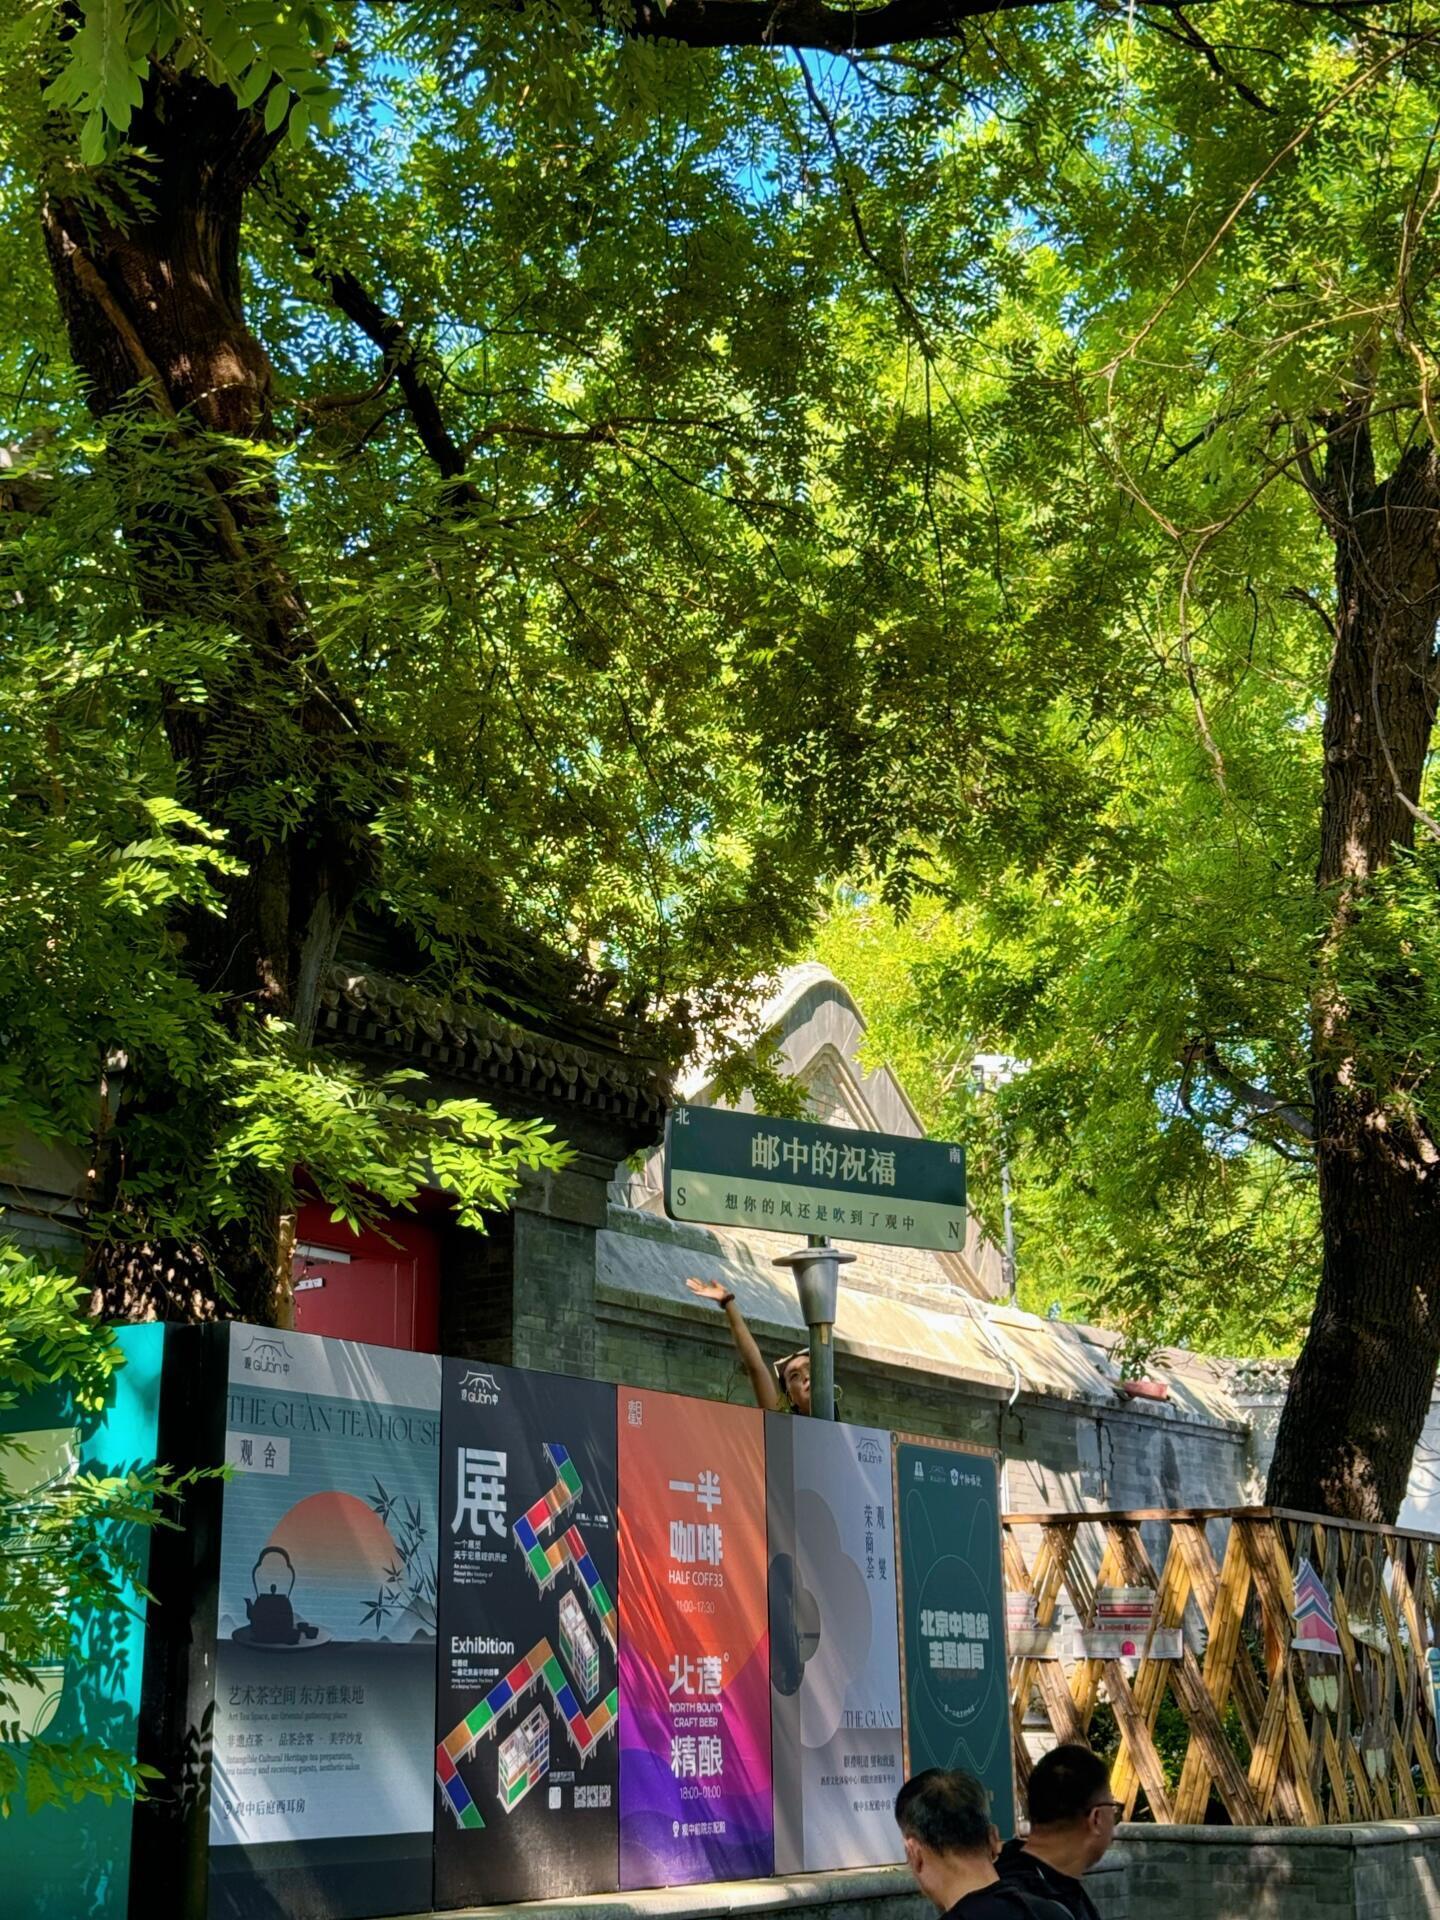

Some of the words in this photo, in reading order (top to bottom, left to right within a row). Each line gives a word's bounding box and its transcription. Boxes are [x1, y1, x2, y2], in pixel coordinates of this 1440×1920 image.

[675, 1107, 690, 1126] 北
[751, 1132, 896, 1187] 邮中的祝福
[949, 1147, 961, 1164] 南
[676, 1187, 687, 1206] S
[725, 1192, 915, 1229] 想你的风还是吹到了观中
[948, 1221, 960, 1239] N
[228, 1395, 266, 1425] THE
[451, 1447, 507, 1538] 展
[669, 1469, 722, 1512] 一半
[669, 1519, 723, 1566] 咖啡
[668, 1570, 691, 1585] HALF
[920, 1609, 989, 1640] 北京中轴线
[451, 1635, 515, 1655] Exhibition
[929, 1641, 985, 1670] 主题邮局
[228, 1685, 296, 1706] 艺术茶空间
[300, 1685, 364, 1705] 东方雅集地
[669, 1702, 696, 1713] NORTH
[696, 1702, 723, 1713] BOUND
[674, 1716, 698, 1728] CRAFT
[699, 1716, 718, 1728] BEER
[844, 1710, 863, 1728] THE
[670, 1735, 723, 1779] 精酿
[680, 1785, 721, 1800] 18:00-01:00
